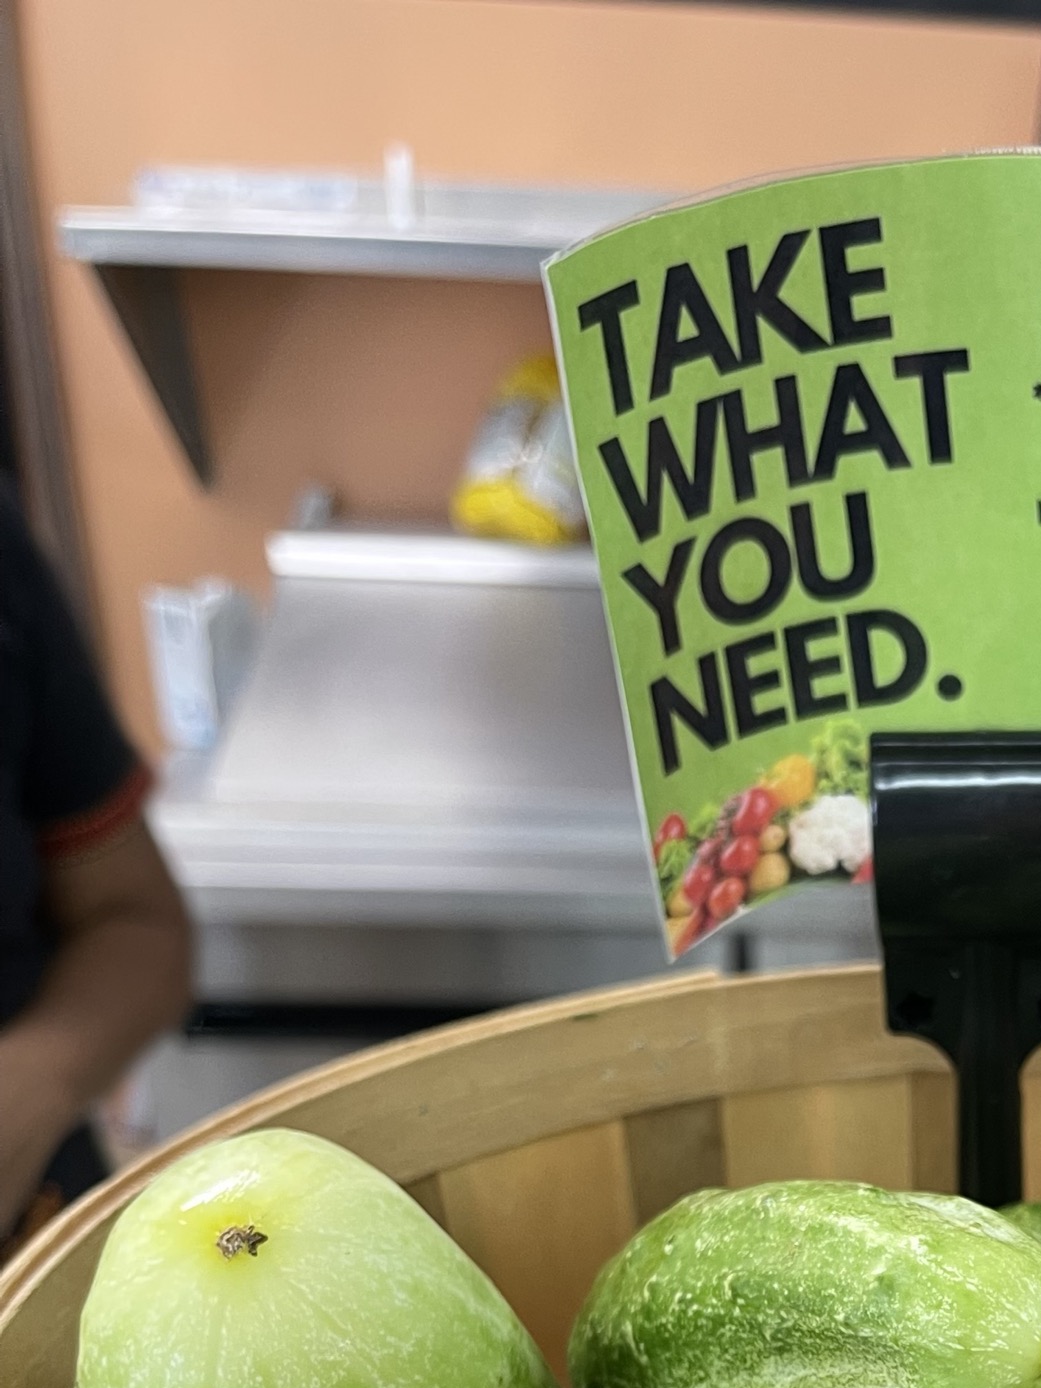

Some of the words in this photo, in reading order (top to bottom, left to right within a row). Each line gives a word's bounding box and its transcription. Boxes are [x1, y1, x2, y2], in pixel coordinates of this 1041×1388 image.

[577, 217, 893, 417] TAKE
[598, 349, 970, 543] WHAT
[621, 491, 876, 658] YOU
[649, 609, 964, 778] NEED.
